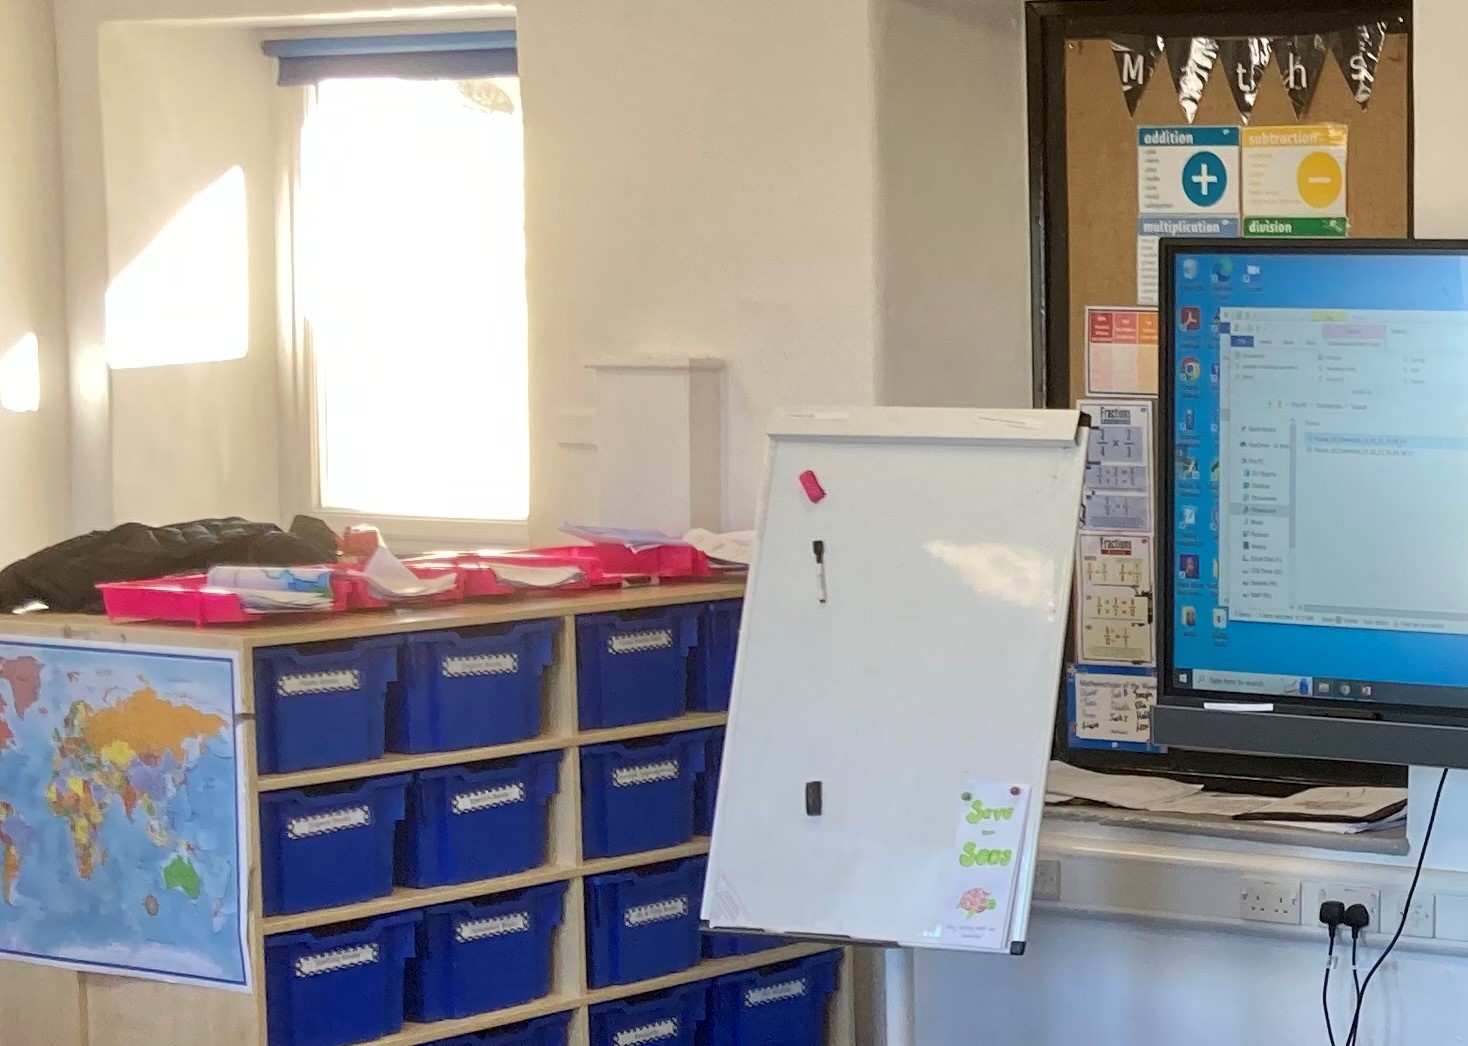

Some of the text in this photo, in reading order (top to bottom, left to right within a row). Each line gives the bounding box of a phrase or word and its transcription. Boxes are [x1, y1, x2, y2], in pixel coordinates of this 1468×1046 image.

[1143, 131, 1194, 145] addition
[1249, 131, 1318, 145] subtraction
[1143, 219, 1221, 236] multiplication
[1249, 220, 1292, 233] division
